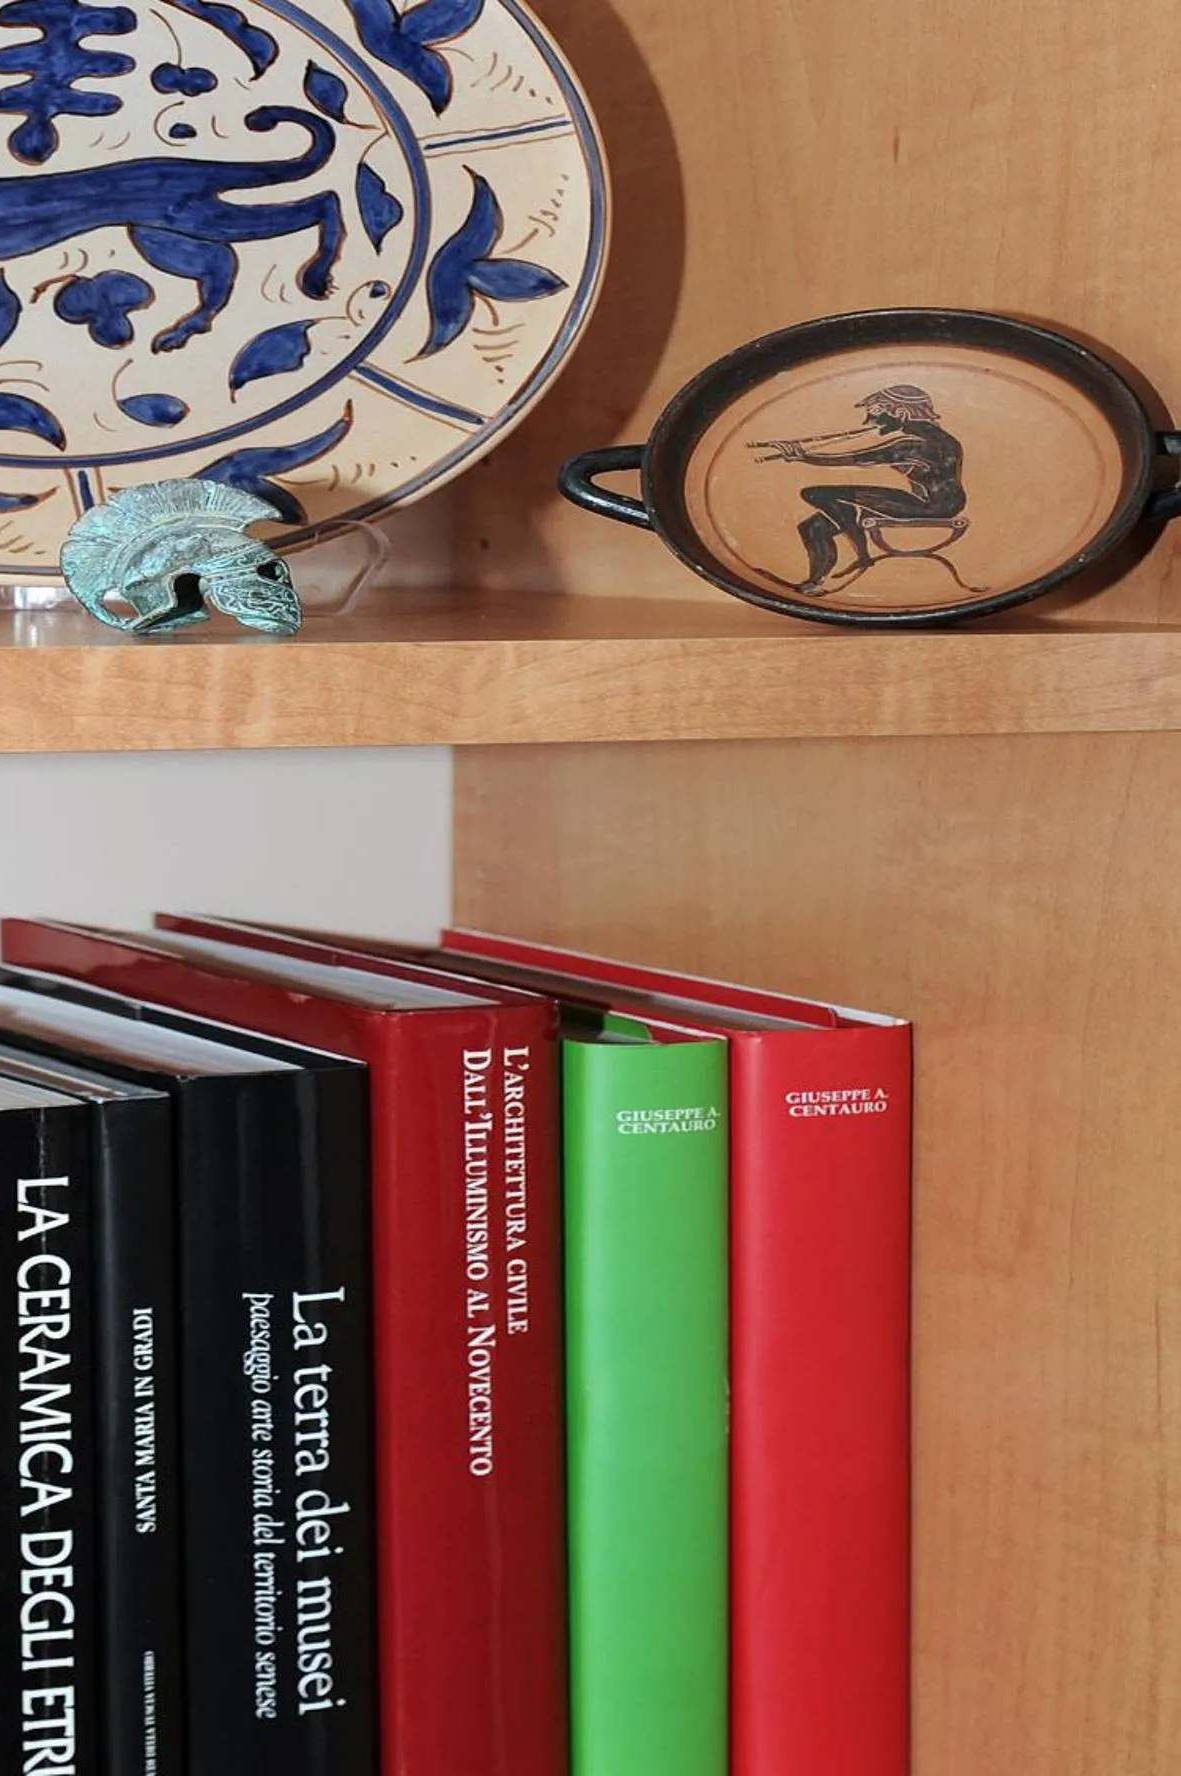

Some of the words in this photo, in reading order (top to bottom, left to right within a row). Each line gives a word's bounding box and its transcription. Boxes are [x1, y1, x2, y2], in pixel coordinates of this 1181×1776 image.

[615, 1107, 704, 1123] GIUSEPPE
[617, 1118, 717, 1135] CENTAURO
[784, 1088, 872, 1105] GIUSEPPE
[788, 1100, 888, 1118] CENTAURO
[17, 1175, 70, 1242] LA
[132, 1307, 154, 1371] GRADI
[241, 1292, 280, 1394] paesaggio
[292, 1286, 345, 1351] La
[16, 1254, 74, 1517] CERAMICA
[134, 1375, 155, 1398] IN
[134, 1401, 156, 1466] MARIA
[250, 1399, 274, 1442] arte
[293, 1364, 334, 1477] terra
[134, 1470, 157, 1534] SANTA
[251, 1448, 281, 1508] storia
[252, 1513, 286, 1546] del
[295, 1489, 351, 1563] dei
[20, 1529, 75, 1671] DEGLI
[253, 1552, 284, 1645] territorio
[297, 1576, 347, 1715] musei
[254, 1651, 278, 1719] senese
